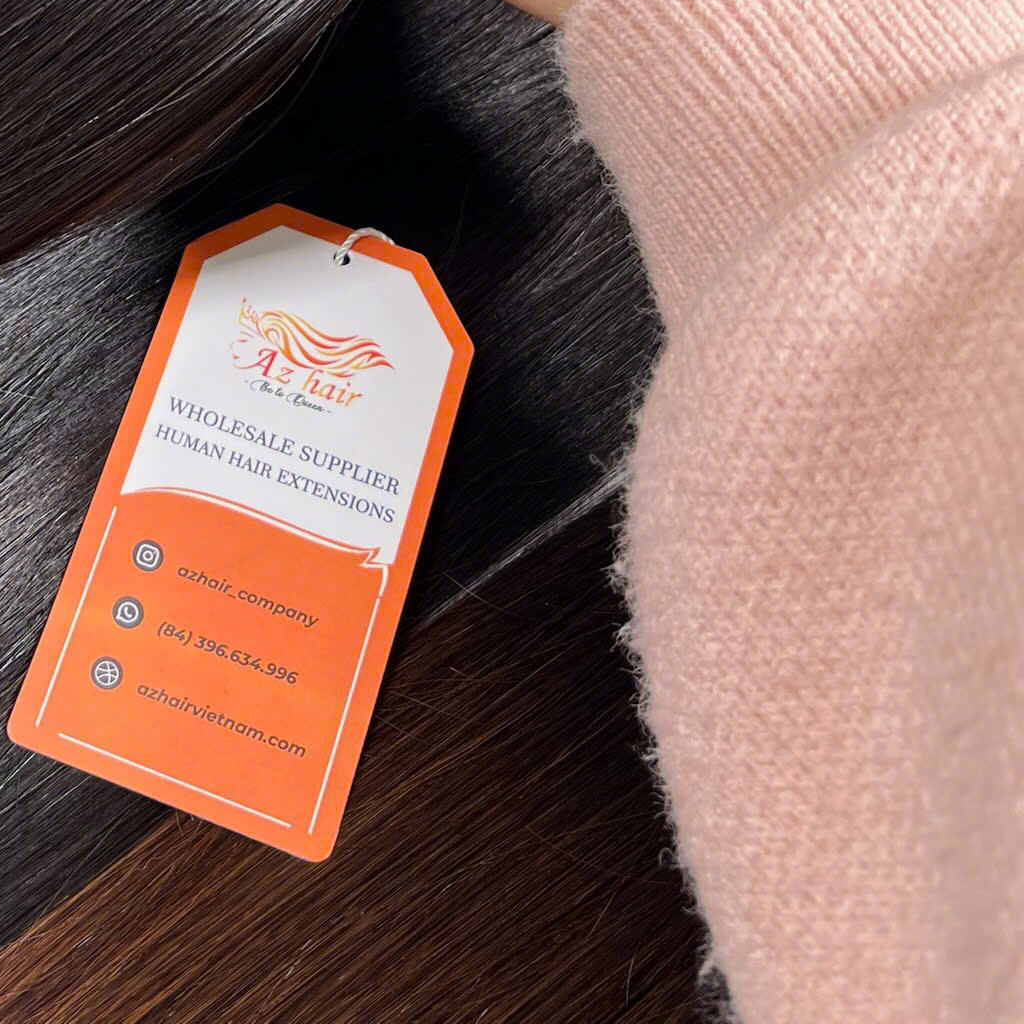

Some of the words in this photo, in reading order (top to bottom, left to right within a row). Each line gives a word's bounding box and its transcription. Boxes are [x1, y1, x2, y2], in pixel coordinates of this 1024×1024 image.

[246, 347, 295, 385] Az
[301, 368, 363, 409] hair
[286, 392, 326, 413] Queen
[155, 423, 226, 460] HUMAN
[228, 449, 273, 479] HAIR
[277, 463, 396, 524] EXTENSIONS
[169, 396, 295, 456] WHOLESALE
[299, 445, 400, 496] SUPPLIER
[177, 564, 320, 629] azhair_company
[156, 620, 193, 647] (84)
[194, 635, 299, 685] 396.634.996
[137, 683, 306, 758] azhairvietnam.com
